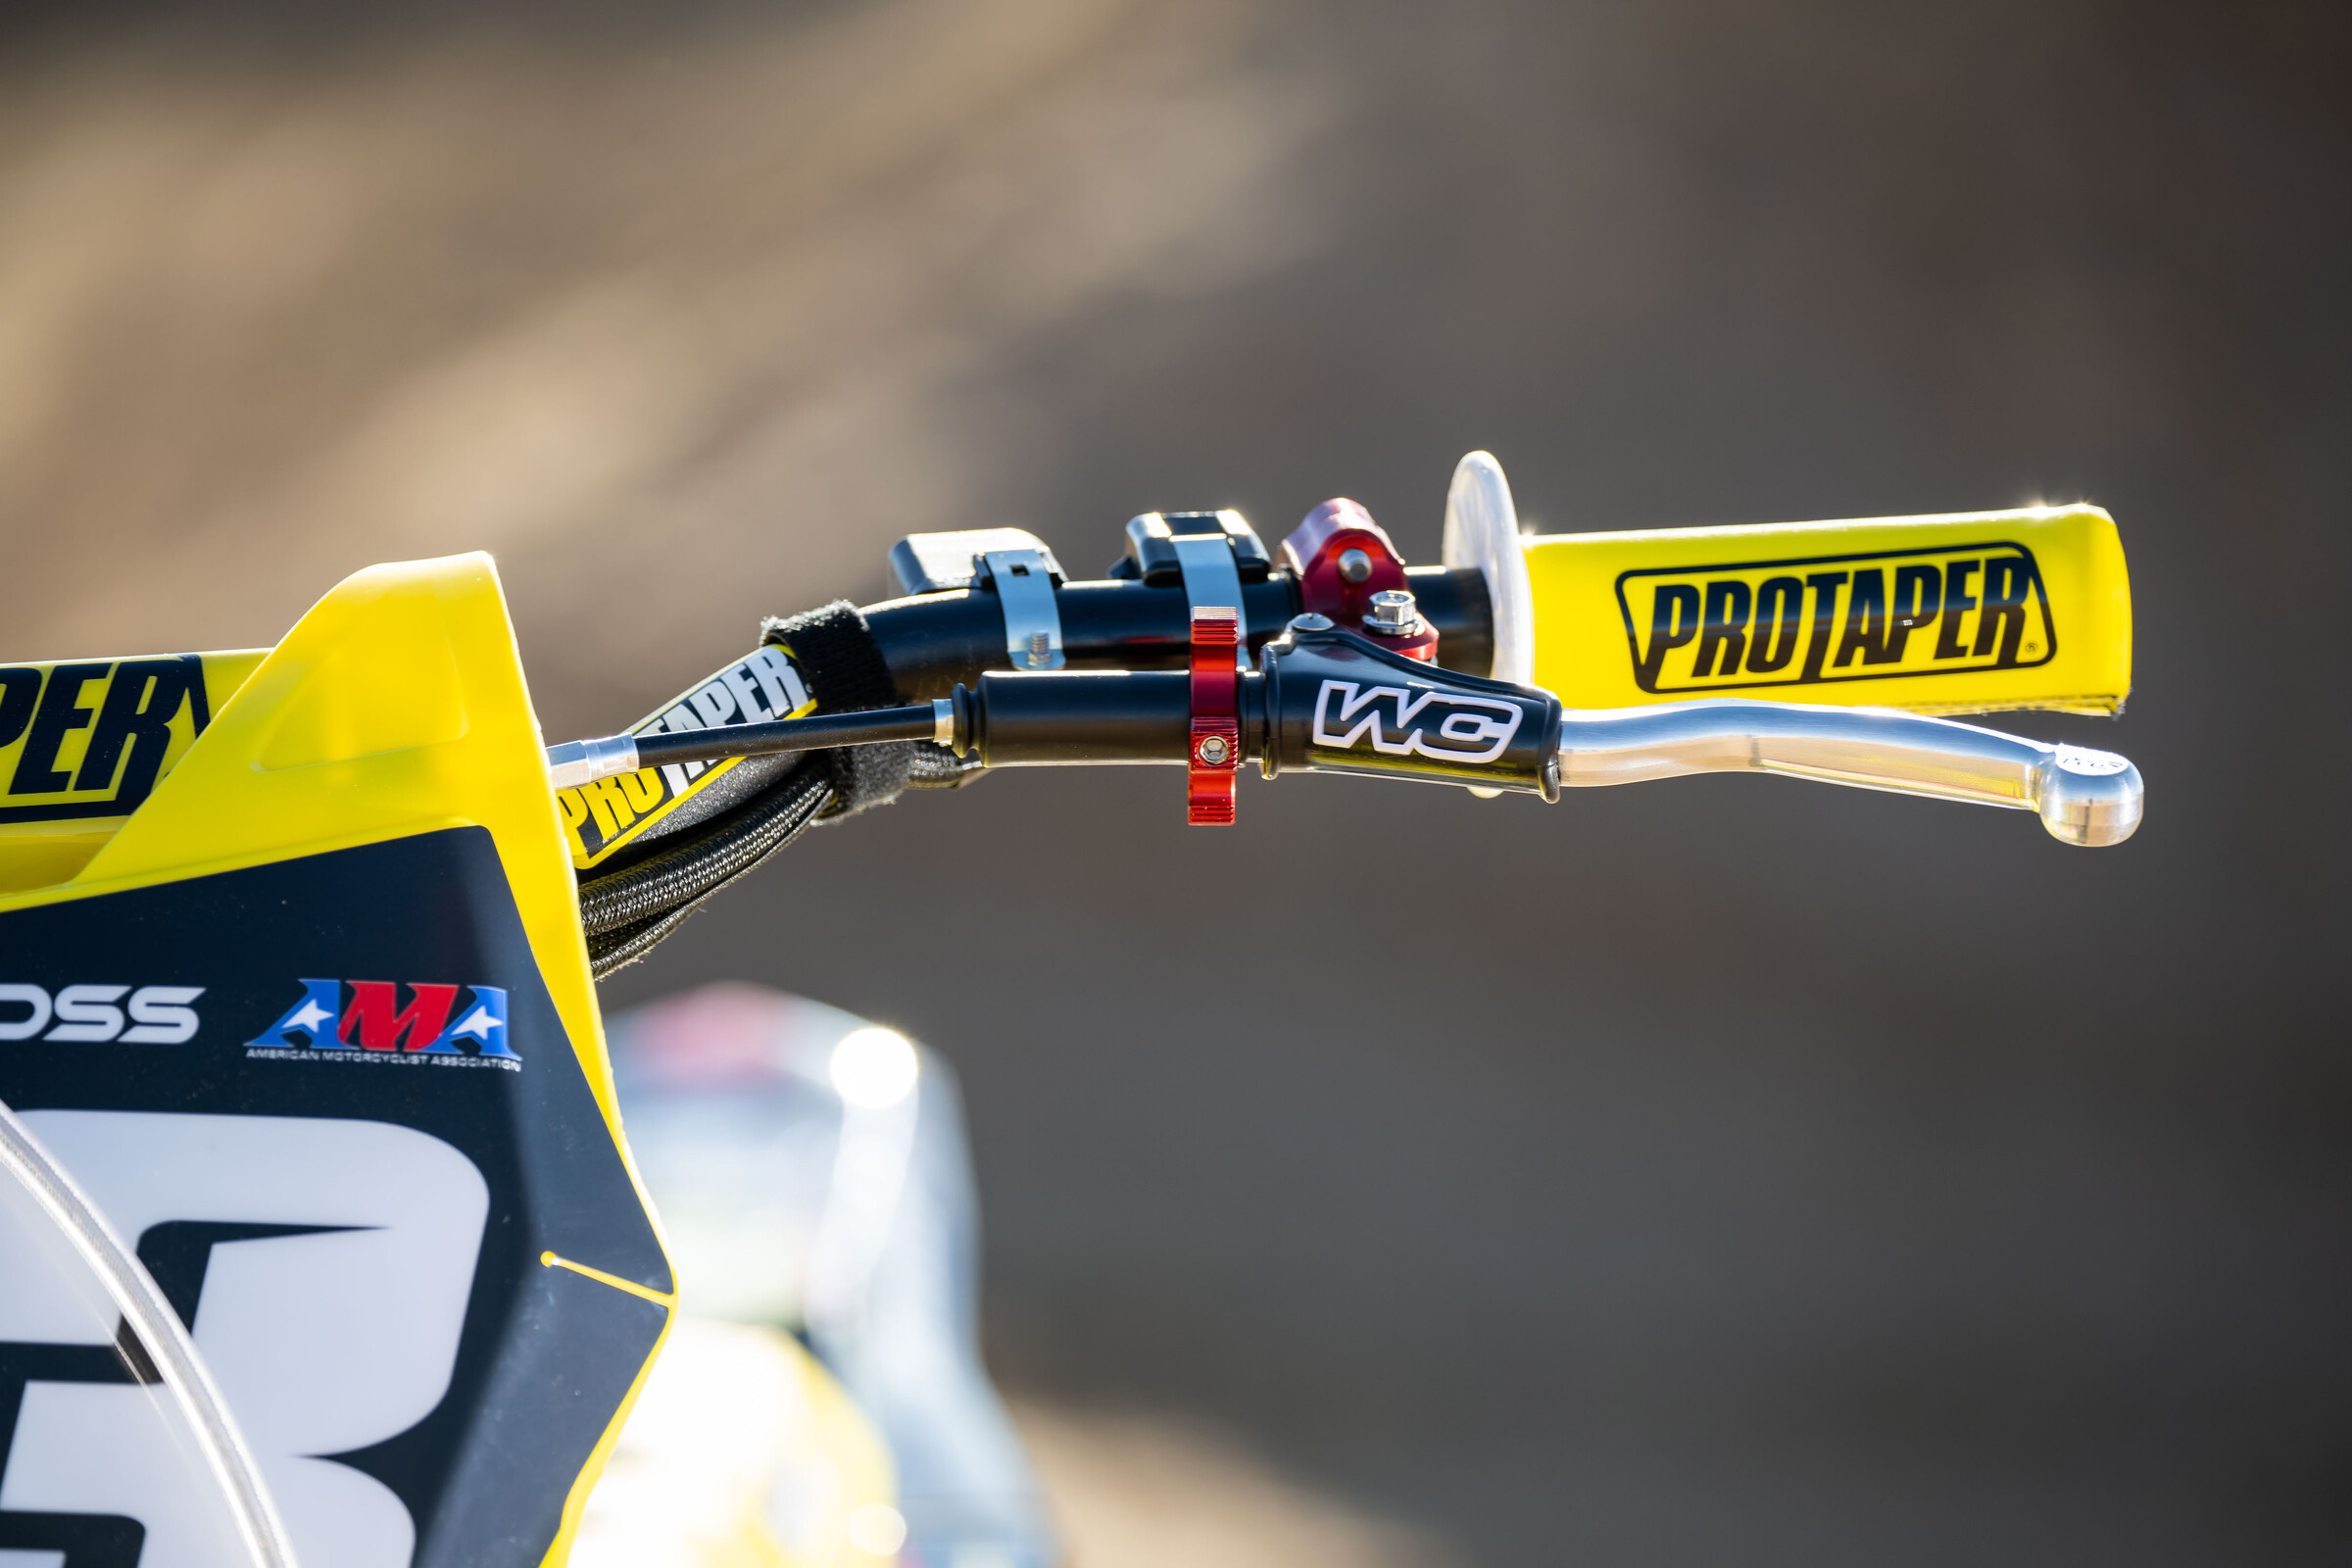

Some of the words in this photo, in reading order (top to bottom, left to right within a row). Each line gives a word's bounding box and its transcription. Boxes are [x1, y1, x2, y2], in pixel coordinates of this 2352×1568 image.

[1642, 556, 2029, 690] PROTAPER
[1313, 679, 1524, 764] WC
[243, 978, 522, 1060] AMA
[245, 1048, 319, 1060] AMERICAN
[322, 1050, 428, 1065] MOTORCYCLIST
[430, 1054, 522, 1073] ASSOCIATION
